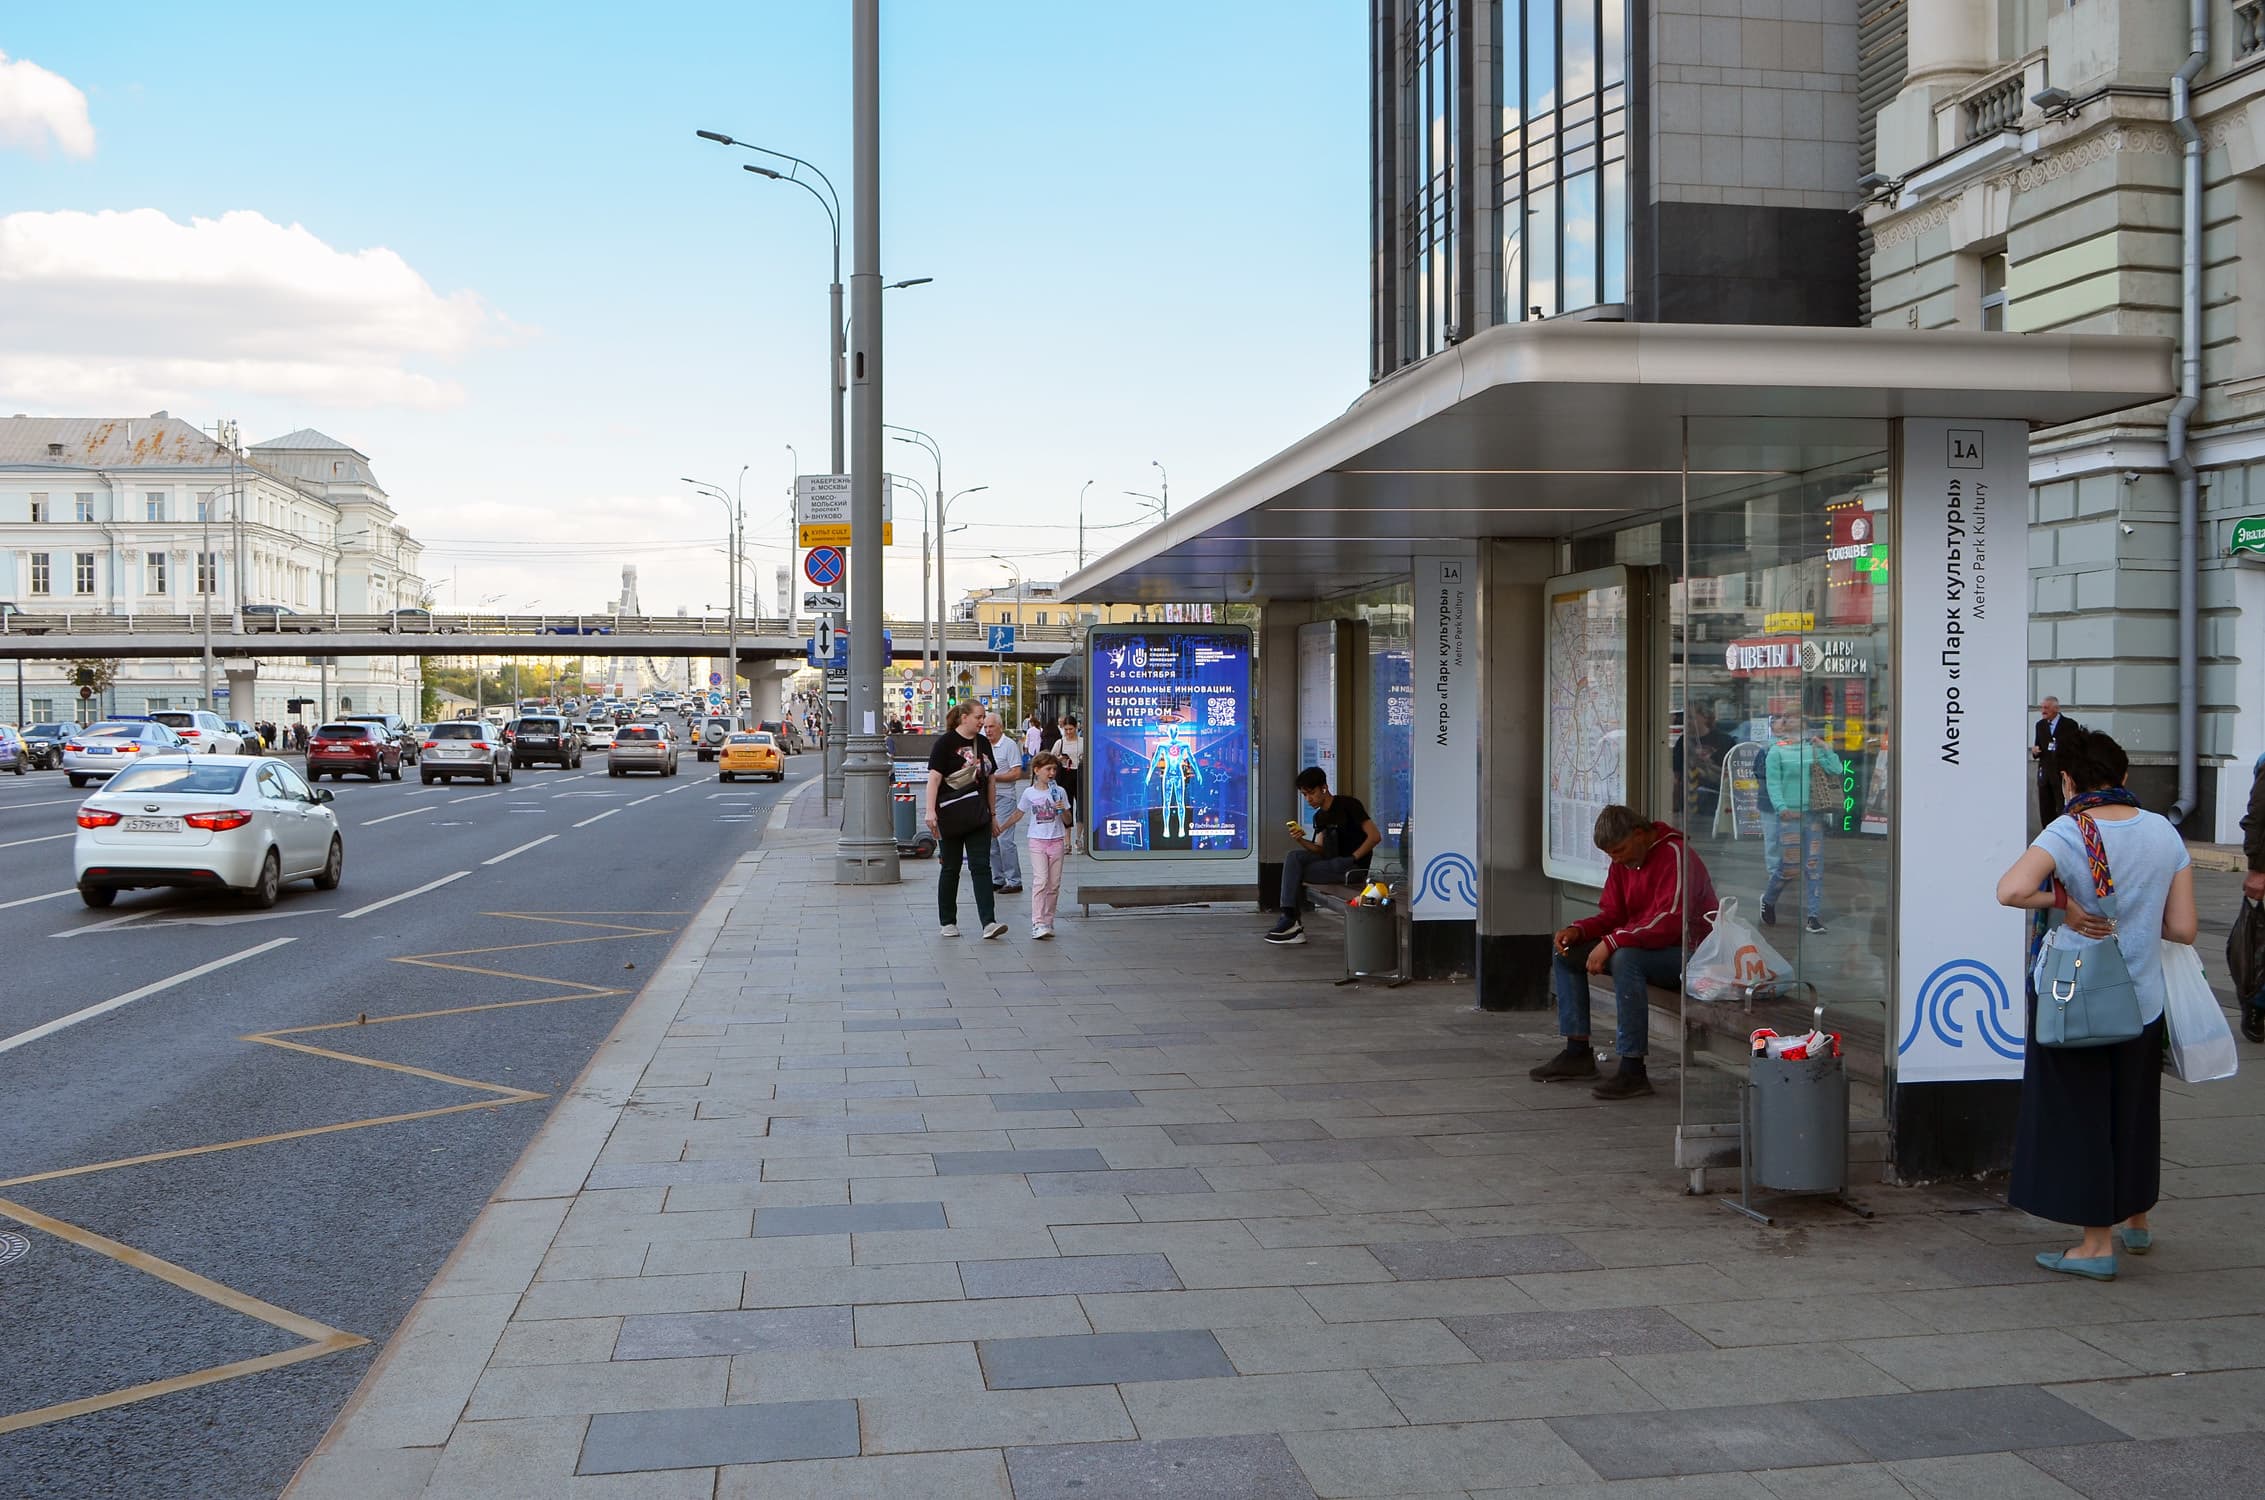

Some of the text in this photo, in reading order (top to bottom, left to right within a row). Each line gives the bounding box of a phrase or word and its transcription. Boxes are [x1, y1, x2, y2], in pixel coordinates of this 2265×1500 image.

[1973, 482, 1988, 620] Metro Park Kultury
[1454, 590, 1465, 666] Metro Park Kultury
[1942, 479, 1966, 765] Метро «Парк культуры»
[1824, 641, 1854, 657] ДАРЫ
[1437, 588, 1452, 746] Метро «Парк культуры»
[1824, 658, 1867, 673] СИБИРИ
[1129, 670, 1176, 678] СЕНТЯБРЯ
[1107, 685, 1235, 694] СОЦИАЛЬНЫЕ ИННОВАЦИИ.
[1107, 697, 1158, 706] ЧЕЛОВЕК
[1107, 708, 1172, 716] НА ПЕРВОМ
[1107, 718, 1143, 727] МЕСТЕ
[1843, 760, 1855, 831] КОФЕ
